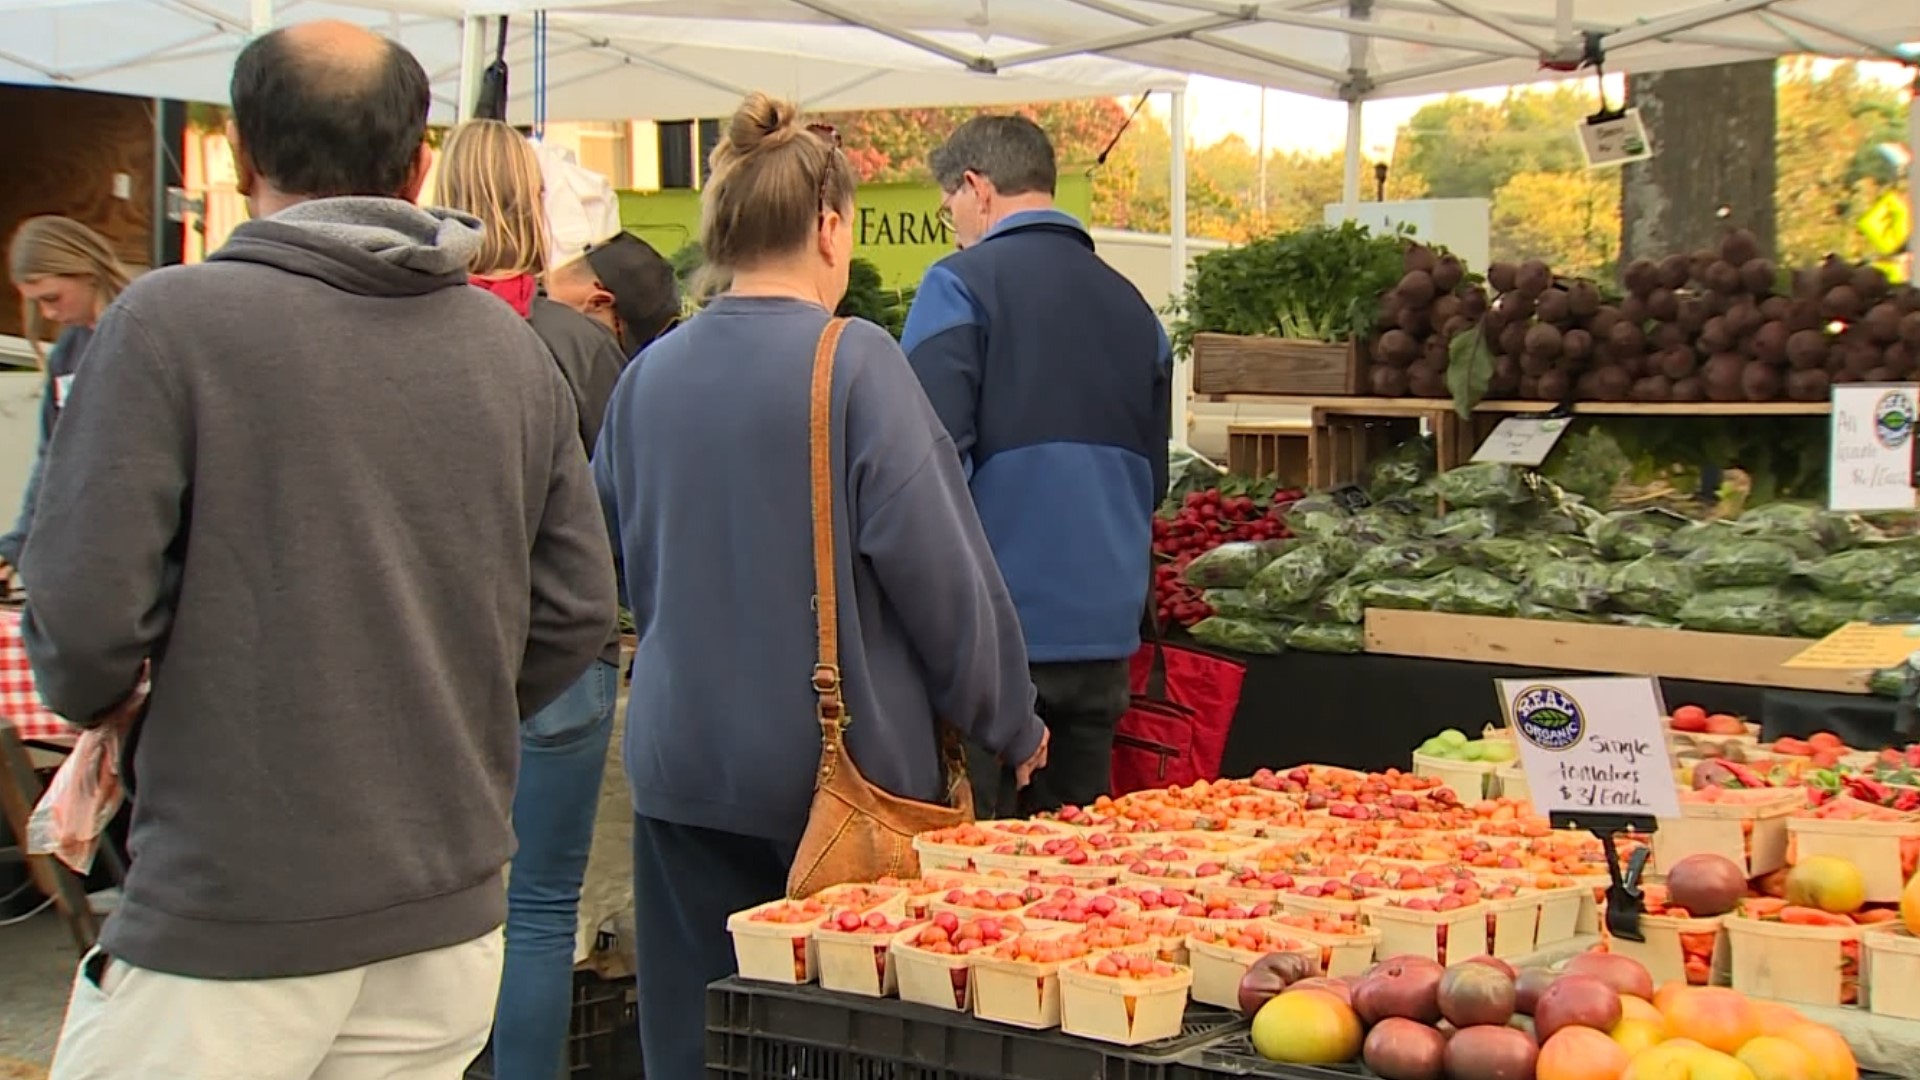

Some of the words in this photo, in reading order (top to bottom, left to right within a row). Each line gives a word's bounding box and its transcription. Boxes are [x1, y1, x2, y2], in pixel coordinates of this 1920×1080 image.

[858, 207, 949, 245] FARM
[1518, 690, 1574, 717] REAL
[1524, 721, 1578, 740] ORGANIC
[1589, 735, 1652, 764] Single
